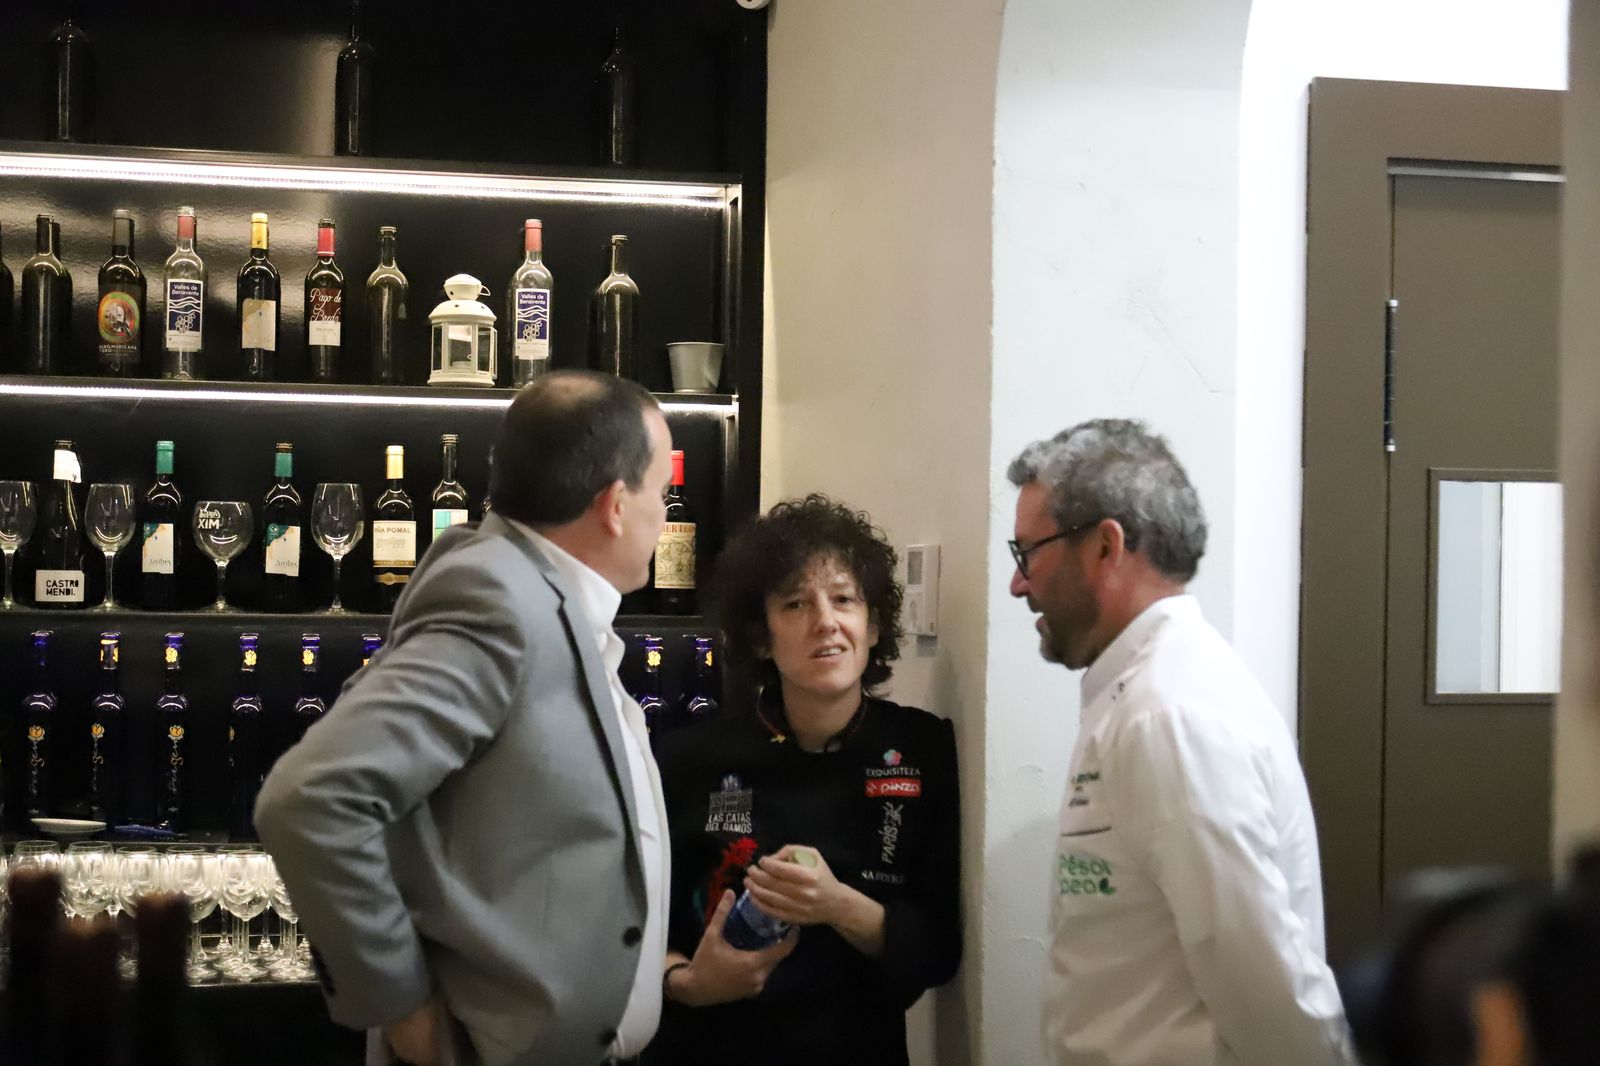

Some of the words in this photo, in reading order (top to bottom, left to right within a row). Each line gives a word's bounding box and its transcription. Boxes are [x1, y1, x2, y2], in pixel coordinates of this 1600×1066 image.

[333, 290, 342, 303] de
[45, 579, 80, 588] CASTRO
[866, 768, 921, 777] EXQUISITEZA
[708, 813, 724, 823] LAS
[725, 811, 751, 823] CATAS
[705, 823, 720, 832] DEL
[722, 822, 752, 834] RAMOS
